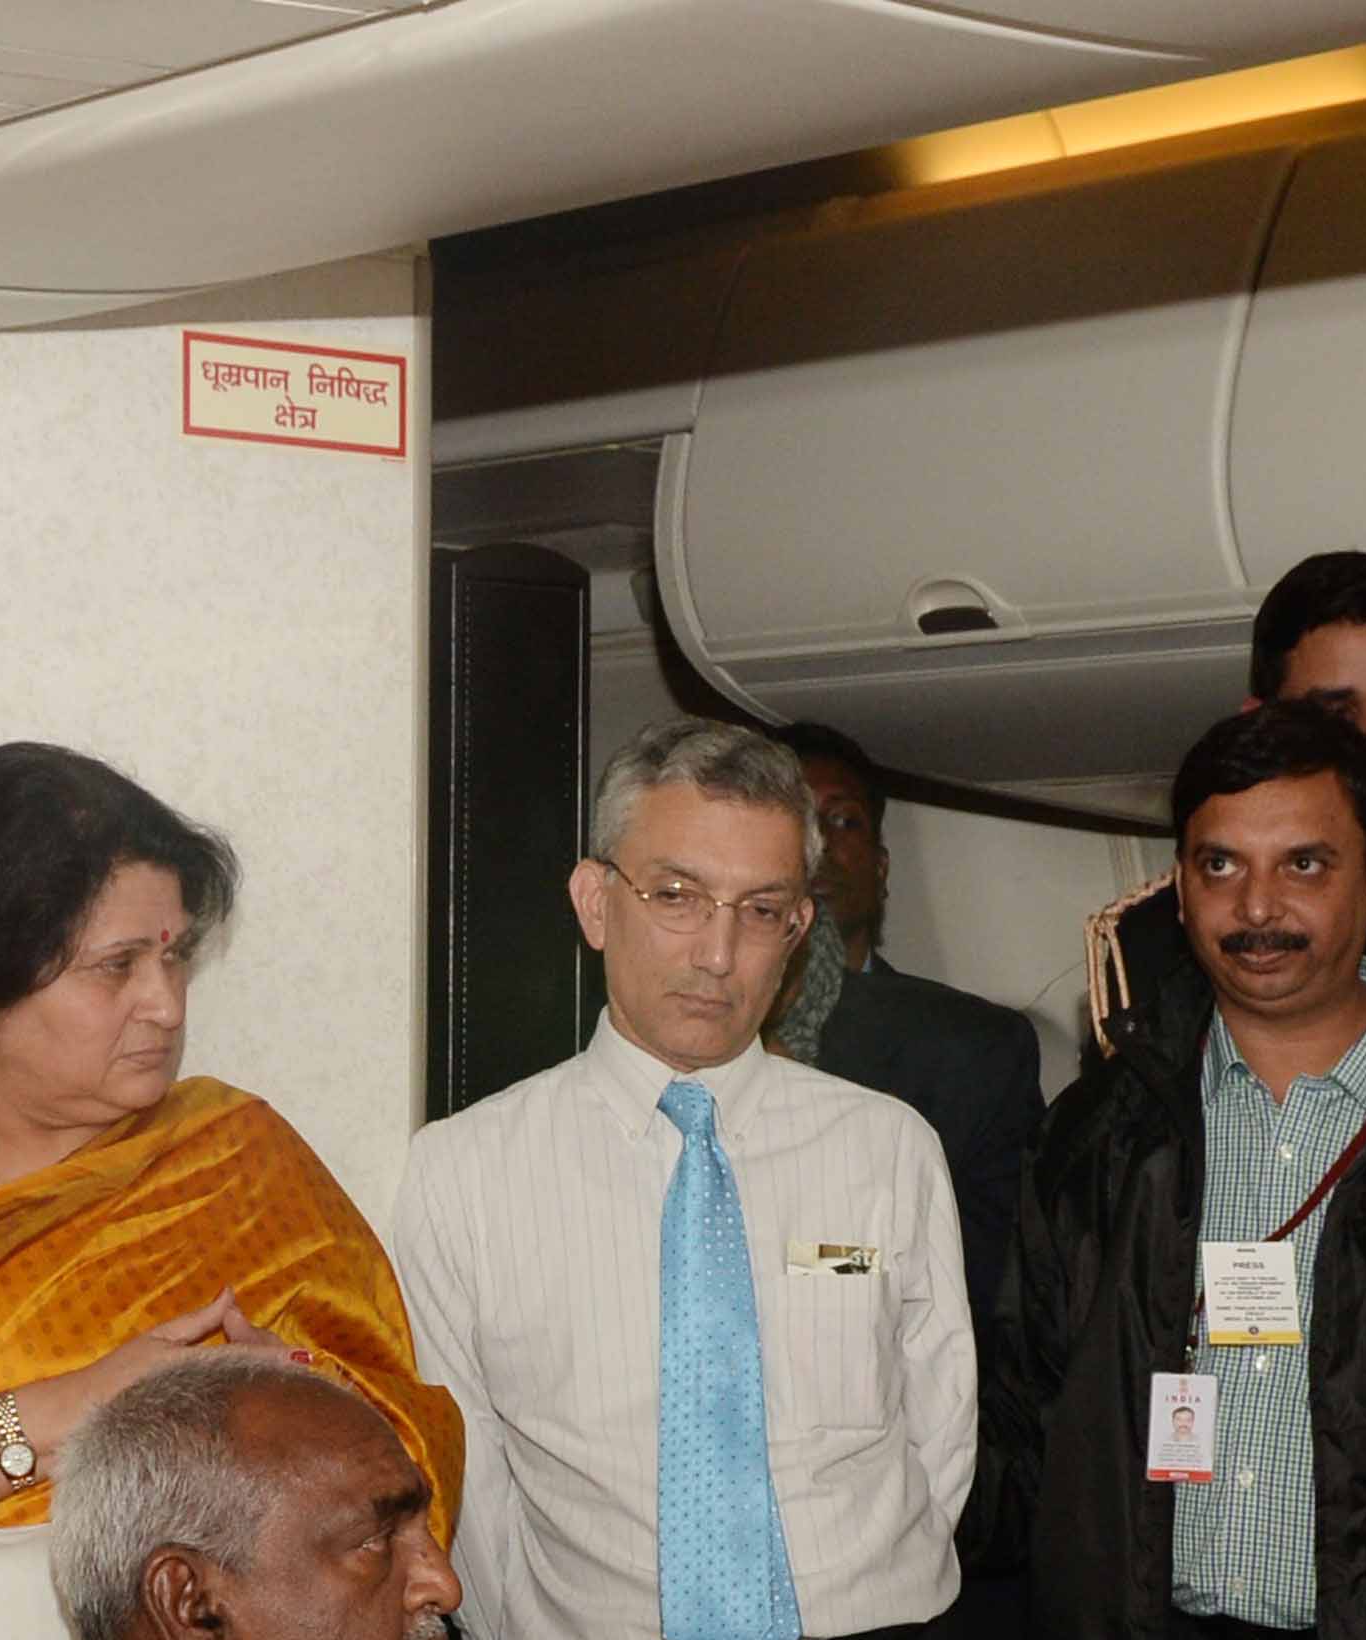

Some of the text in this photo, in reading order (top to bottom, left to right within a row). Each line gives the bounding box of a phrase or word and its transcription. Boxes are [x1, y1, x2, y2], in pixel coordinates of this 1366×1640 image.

[308, 363, 388, 406] निषिद्ध
[274, 396, 317, 429] क्षेत्र
[1232, 1261, 1266, 1270] PRESS
[1165, 1395, 1201, 1403] INDIA
